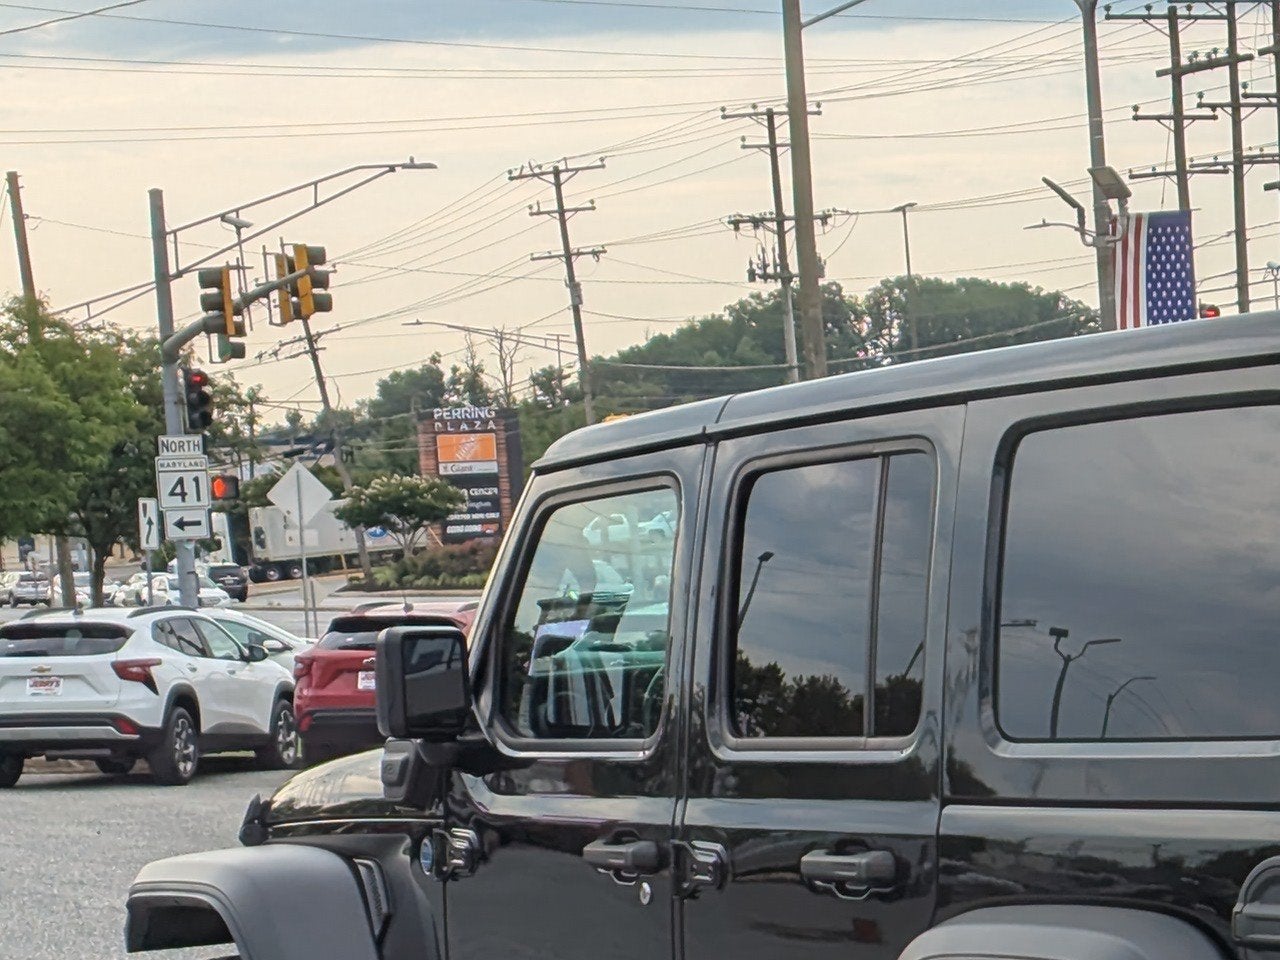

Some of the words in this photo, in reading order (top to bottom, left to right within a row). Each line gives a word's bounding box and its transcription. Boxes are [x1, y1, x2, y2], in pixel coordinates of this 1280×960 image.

[433, 407, 496, 420] PERRING
[434, 420, 497, 432] PLAZA
[161, 440, 200, 453] NORTH
[160, 461, 205, 469] MARYLAND
[168, 476, 201, 503] 41
